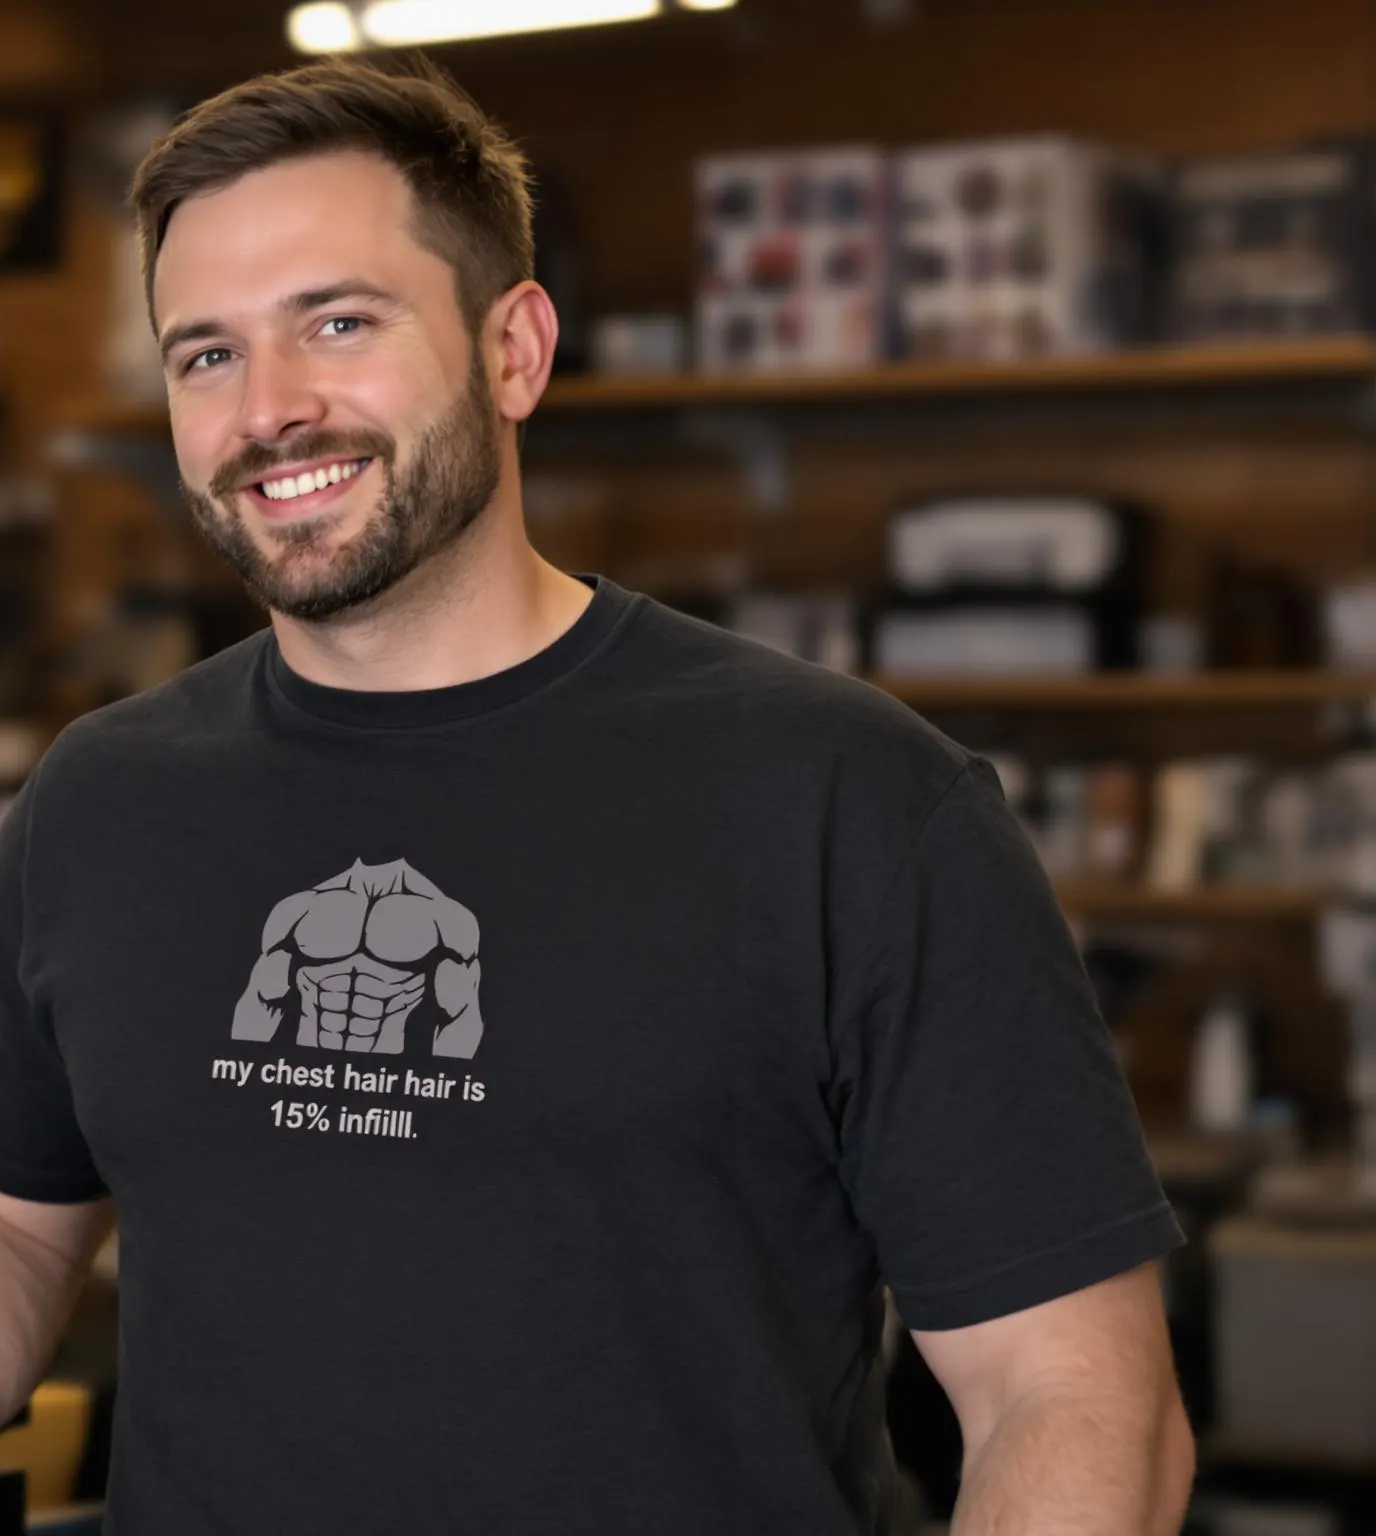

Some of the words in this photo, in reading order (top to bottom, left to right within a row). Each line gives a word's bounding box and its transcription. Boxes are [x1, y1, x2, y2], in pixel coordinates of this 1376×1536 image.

[211, 1059, 254, 1087] my
[260, 1058, 335, 1089] chest
[343, 1063, 399, 1094] hair
[403, 1069, 457, 1099] hair
[462, 1074, 486, 1102] is
[270, 1099, 330, 1132] 15%
